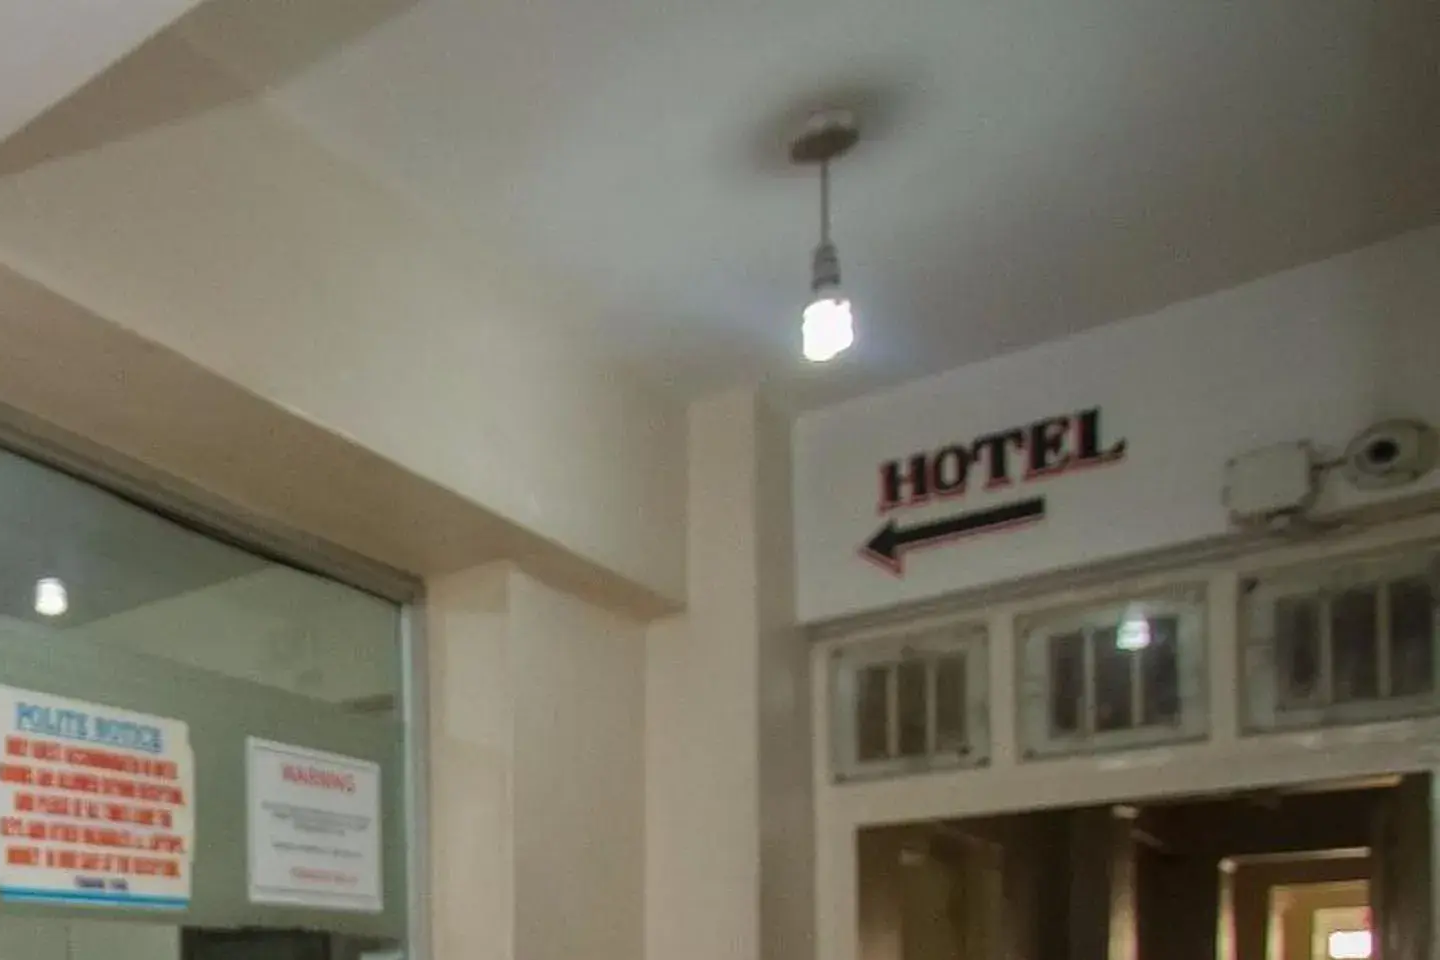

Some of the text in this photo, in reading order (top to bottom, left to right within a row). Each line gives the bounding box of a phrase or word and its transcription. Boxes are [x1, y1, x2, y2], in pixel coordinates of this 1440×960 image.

[877, 406, 1127, 512] HOTEL
[16, 703, 164, 752] POLITE NOTICE
[282, 765, 356, 795] WARNING
